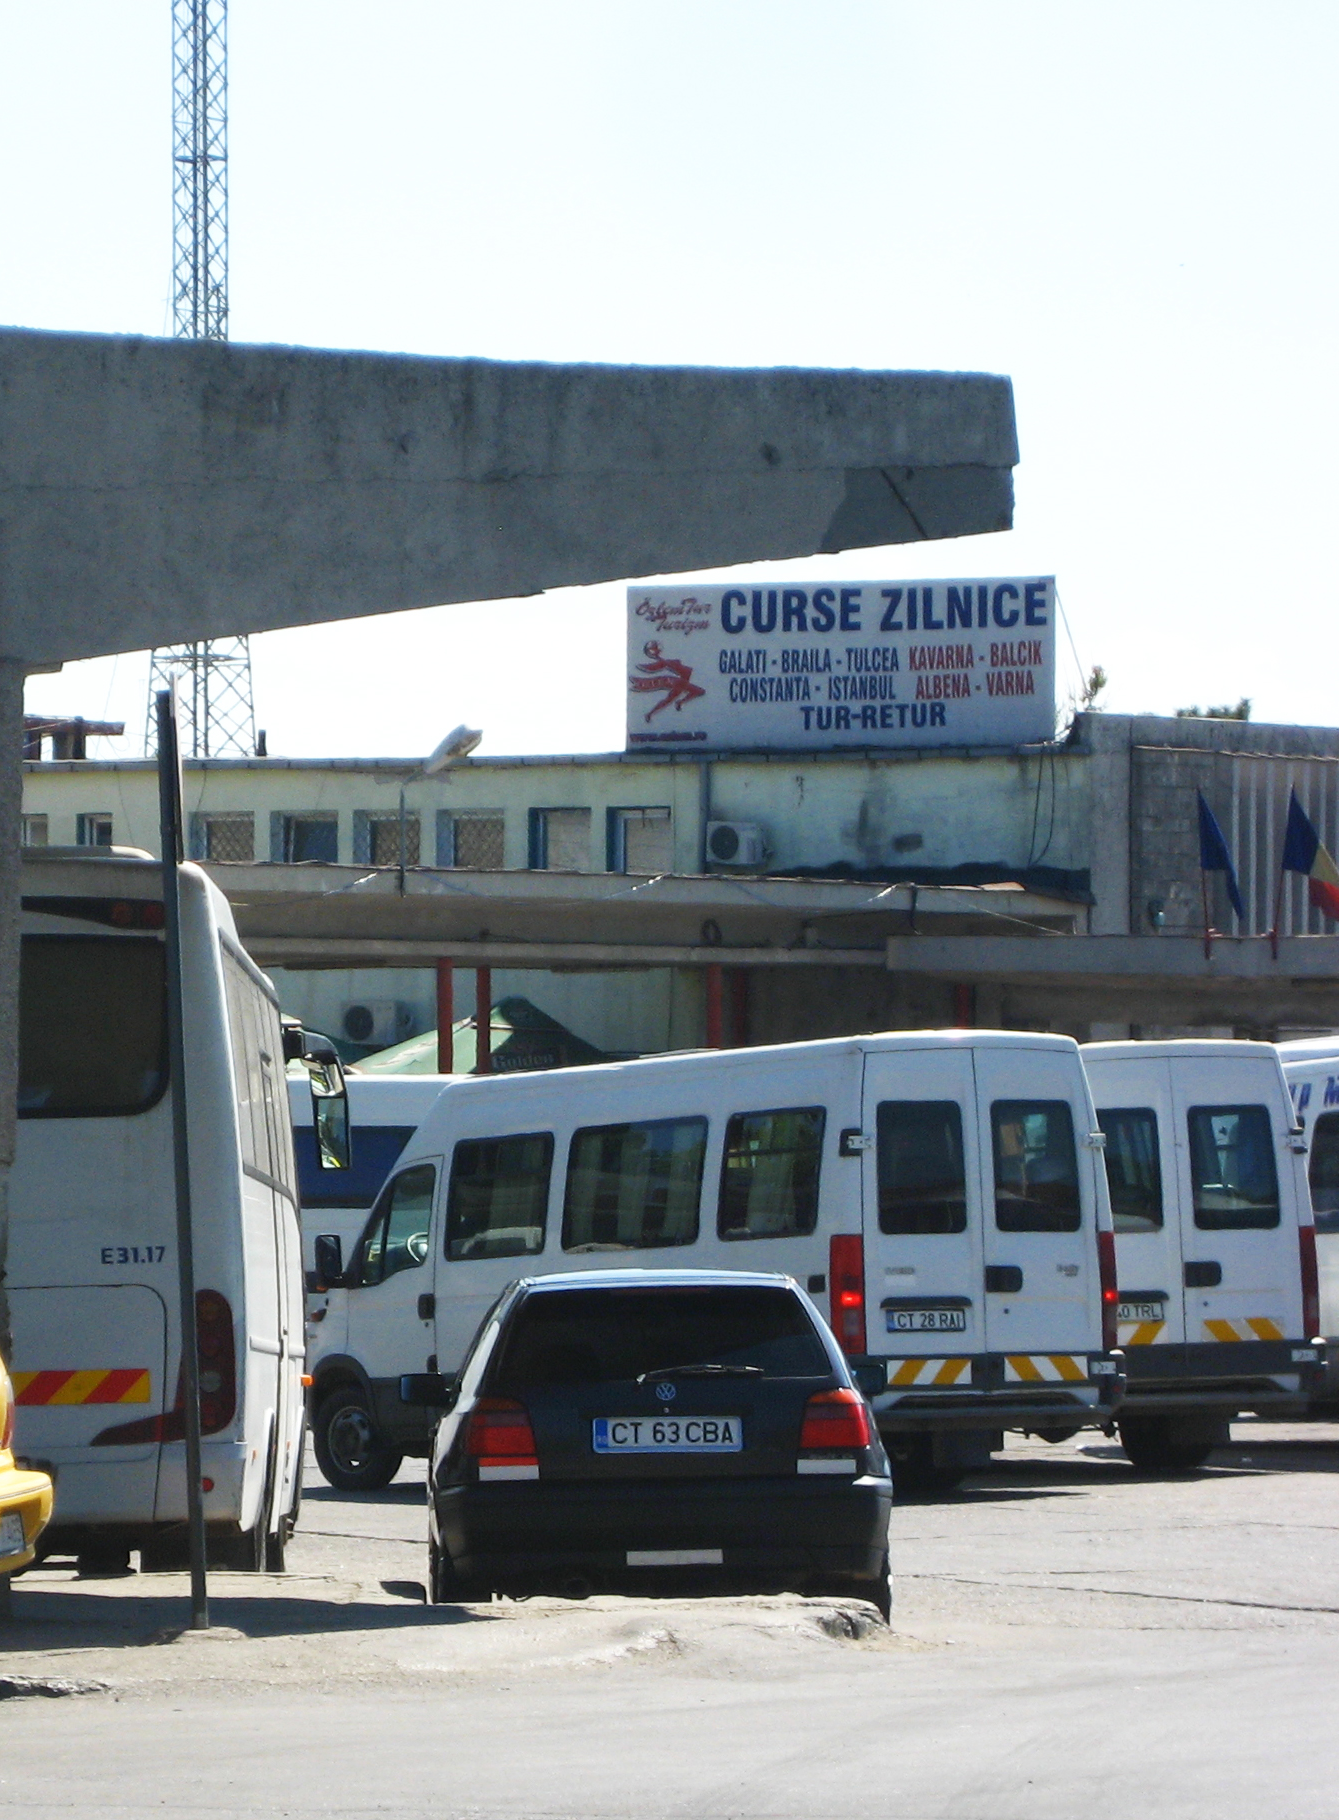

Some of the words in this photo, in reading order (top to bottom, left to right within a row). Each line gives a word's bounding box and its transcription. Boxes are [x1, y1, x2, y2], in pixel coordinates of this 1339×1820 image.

[721, 589, 861, 633] CURSE
[880, 583, 1047, 632] ZILNICE
[719, 649, 766, 674] GALATI
[781, 648, 831, 673] BRAILA
[845, 647, 899, 673] TULCEA
[908, 645, 974, 671] KAVARNA
[990, 641, 1043, 667] BALCIK
[729, 676, 810, 703] CONSTANTA
[828, 674, 897, 702] ISTANBUL
[915, 672, 971, 700] ALBENA
[986, 670, 1035, 697] VARNA
[800, 702, 947, 731] TUR-RETUR
[101, 1246, 165, 1265] E31.17
[897, 1313, 914, 1328] CT
[920, 1313, 935, 1328] 28
[1134, 1304, 1159, 1318] TRL
[612, 1422, 642, 1444] CT
[652, 1421, 680, 1444] 63
[686, 1421, 734, 1444] CBA
